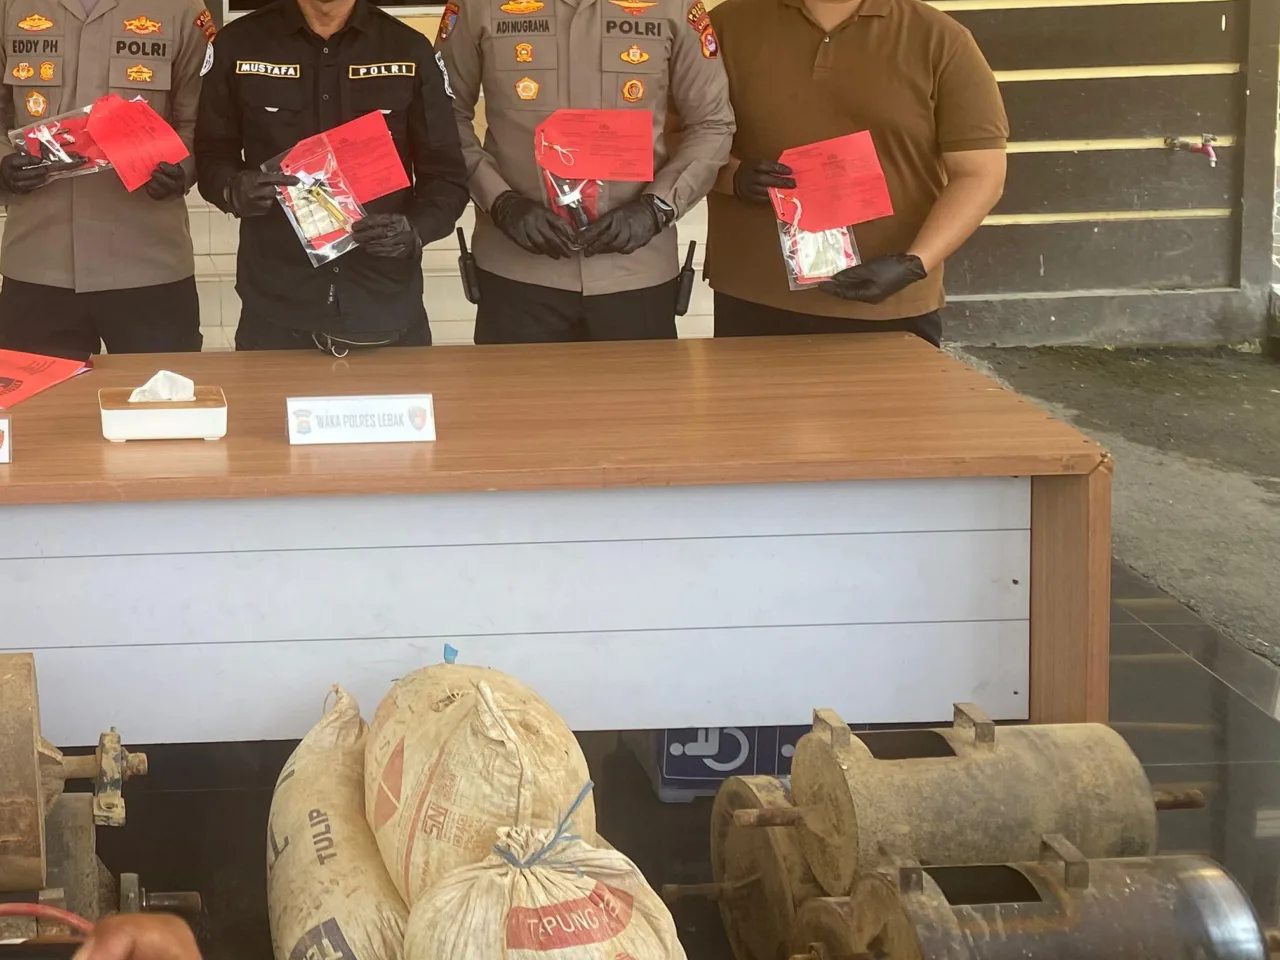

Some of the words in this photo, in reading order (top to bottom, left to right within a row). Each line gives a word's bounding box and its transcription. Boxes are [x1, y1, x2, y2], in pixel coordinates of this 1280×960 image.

[606, 20, 662, 37] POLRI
[12, 39, 39, 54] EDDY
[42, 39, 58, 53] PH
[116, 41, 166, 57] POLRI
[241, 63, 295, 76] MUSTAFA
[359, 65, 407, 76] POLRI
[316, 413, 342, 429] WAKA
[343, 413, 376, 428] POLRES
[377, 412, 404, 427] LEBAK
[308, 807, 338, 866] TULIP
